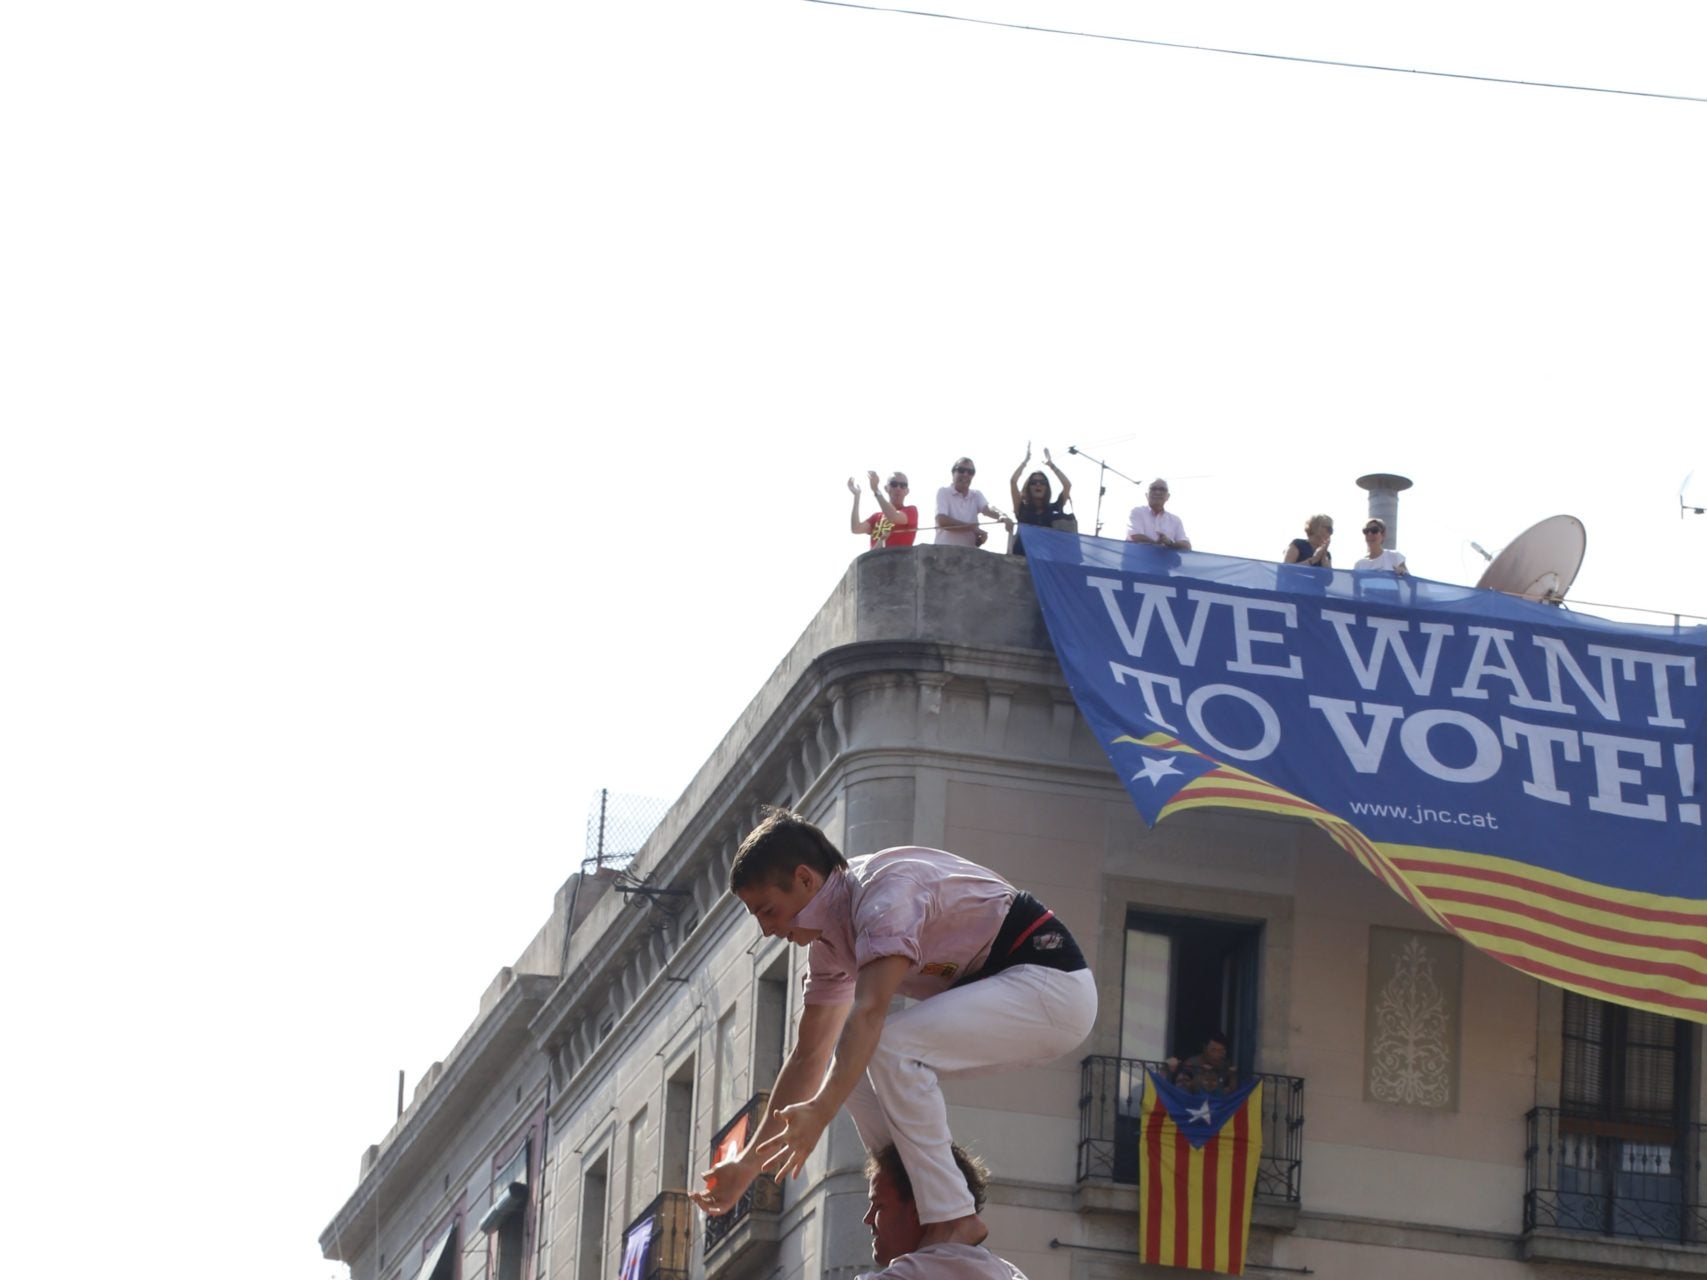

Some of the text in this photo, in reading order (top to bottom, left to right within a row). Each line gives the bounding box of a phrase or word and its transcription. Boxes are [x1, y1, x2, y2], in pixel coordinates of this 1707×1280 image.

[1086, 576, 1698, 729] WE WANT
[1108, 660, 1702, 826] TO VOTE!
[1349, 801, 1499, 830] www.jnc.cat
